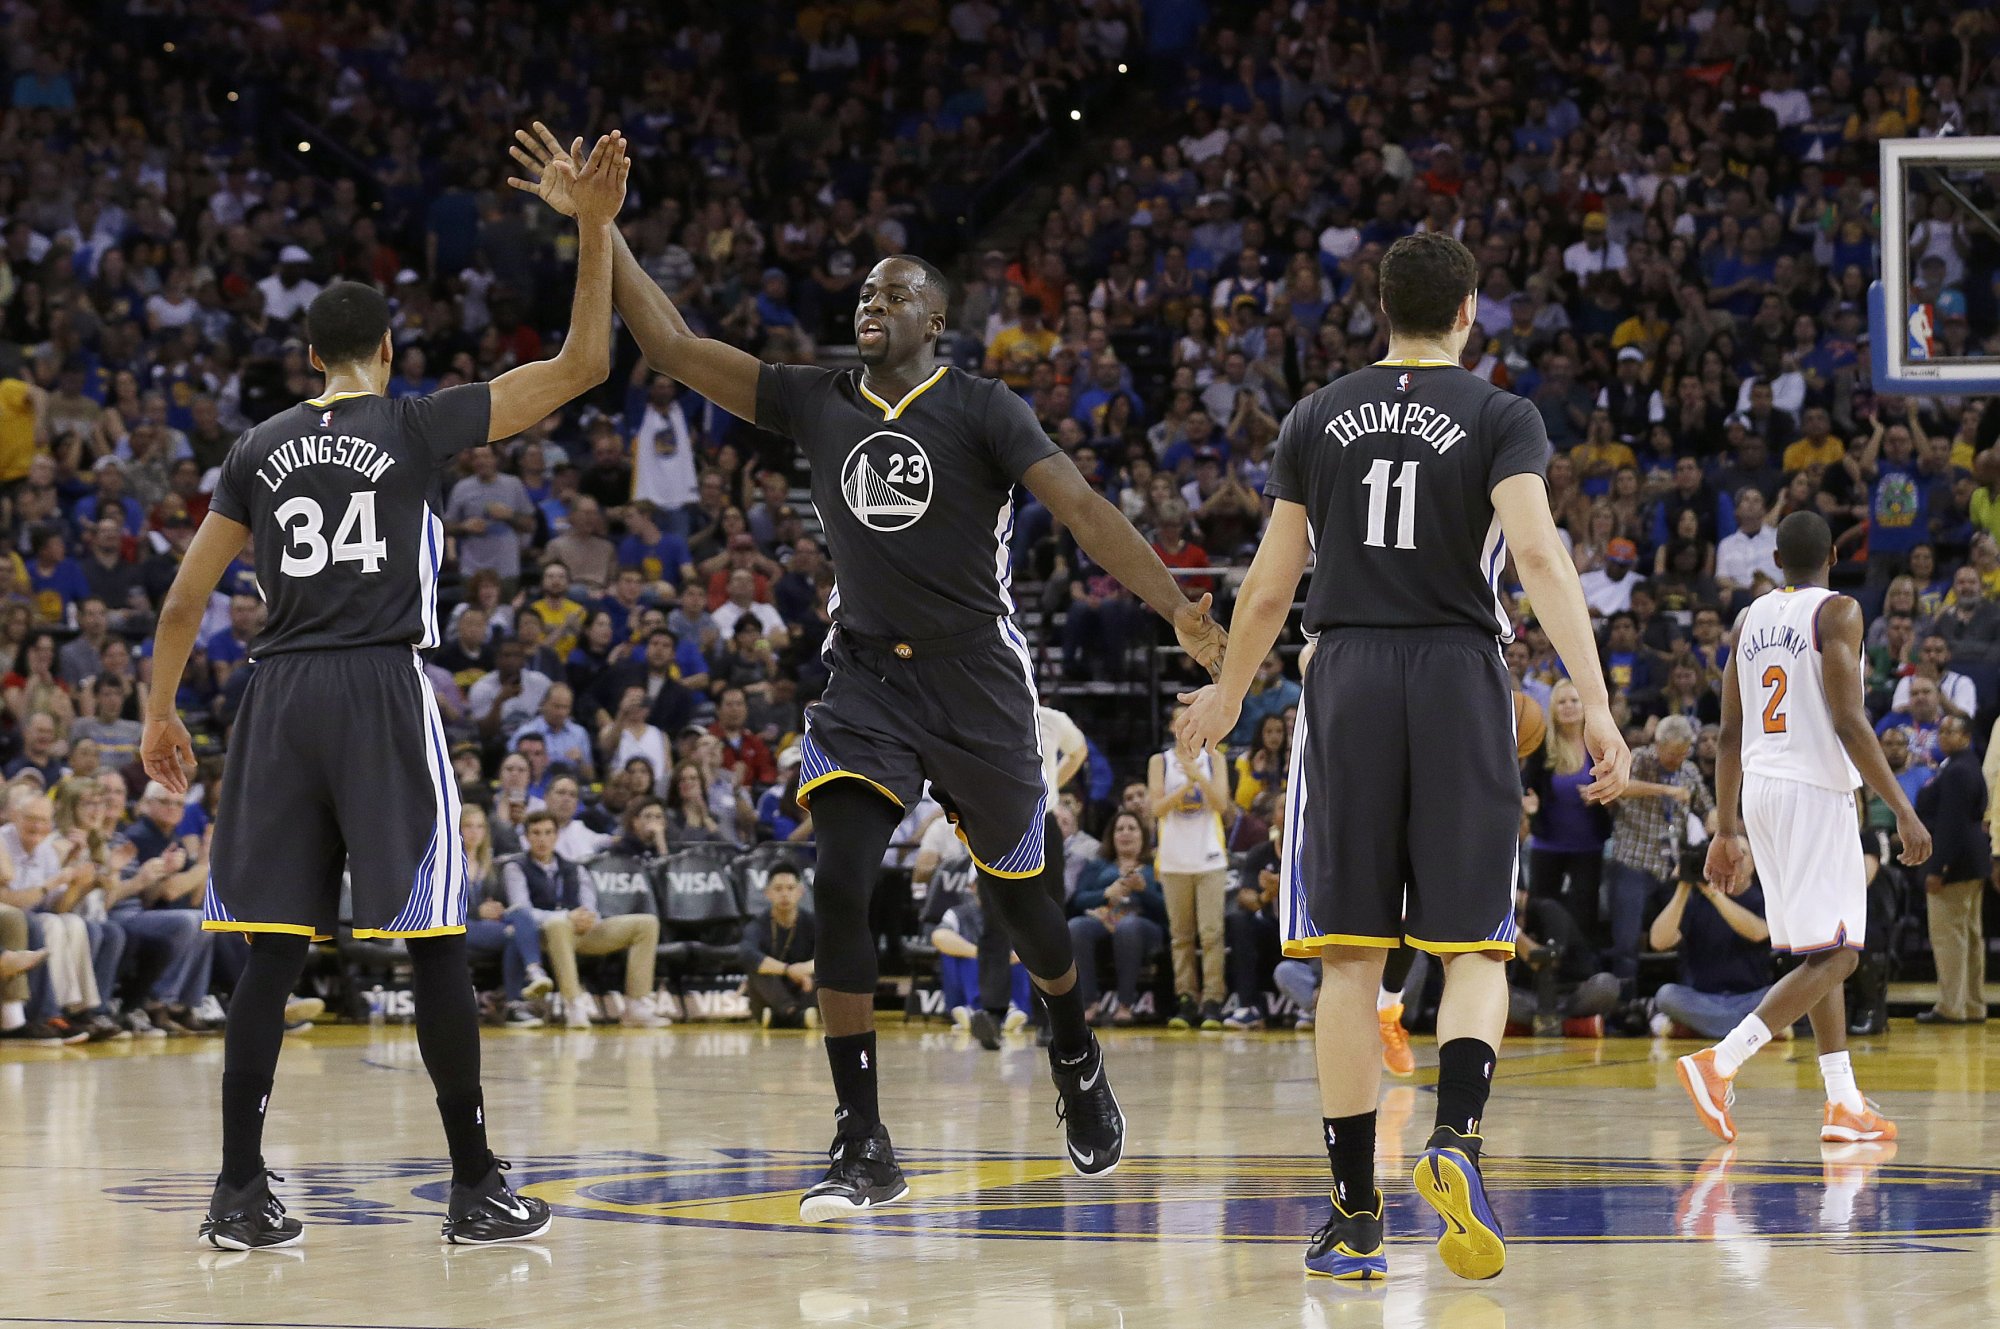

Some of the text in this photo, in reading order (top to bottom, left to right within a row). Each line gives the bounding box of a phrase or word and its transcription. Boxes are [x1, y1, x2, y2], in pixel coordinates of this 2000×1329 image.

[1324, 401, 1467, 455] THOMPSON
[256, 435, 396, 492] LIVINGSTON
[886, 453, 925, 485] 23
[1361, 458, 1420, 549] 11
[273, 490, 388, 578] 34
[1742, 625, 1808, 662] GALLOWAY
[1761, 665, 1788, 733] 2
[592, 871, 649, 893] VISA
[666, 871, 726, 893] VISA
[361, 990, 415, 1016] VIS
